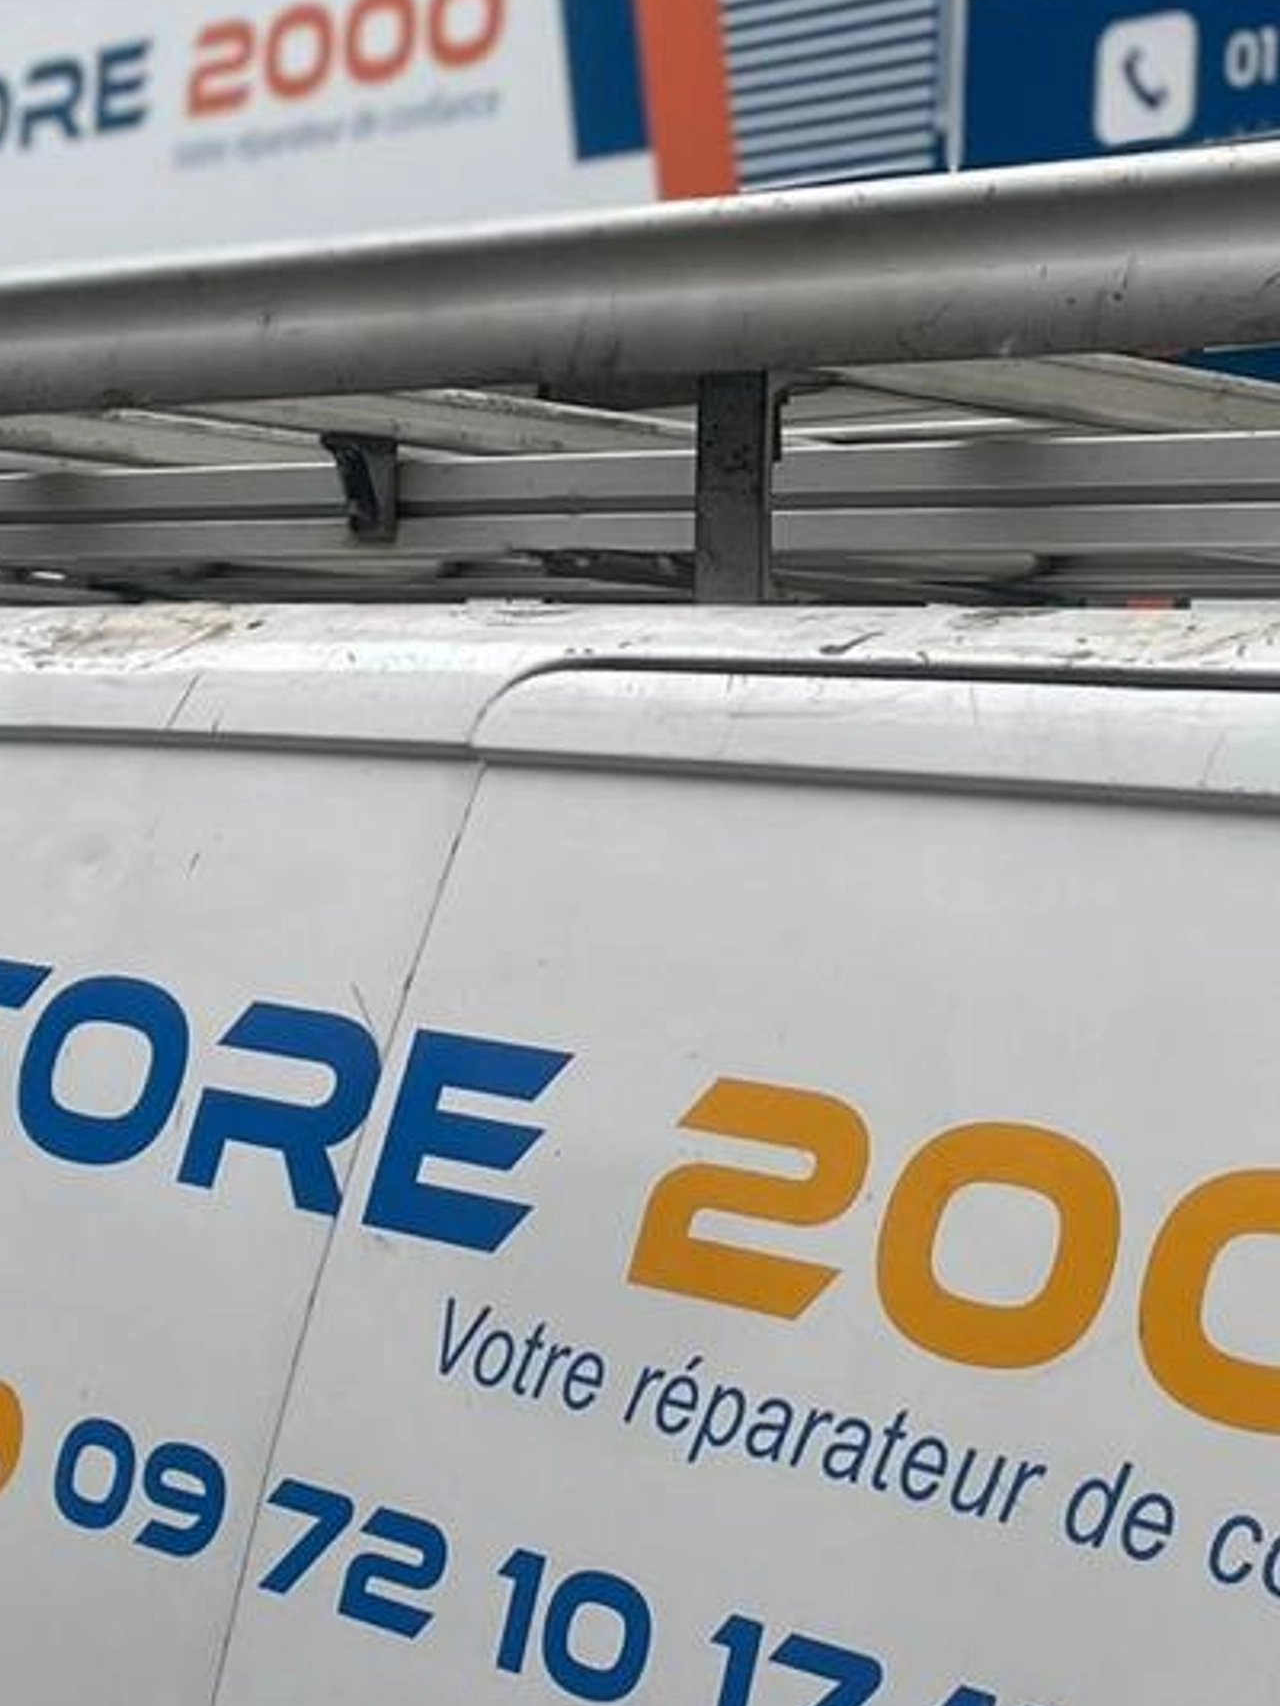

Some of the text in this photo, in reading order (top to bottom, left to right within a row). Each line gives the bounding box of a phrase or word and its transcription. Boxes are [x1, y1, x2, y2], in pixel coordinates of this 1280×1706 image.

[1225, 27, 1280, 89] 01
[52, 1416, 228, 1559] 09
[258, 1479, 450, 1640] 72
[496, 1548, 653, 1704] 10
[437, 1296, 605, 1411] Votre
[623, 1355, 1048, 1524] réparateur
[1064, 1461, 1175, 1562] de
